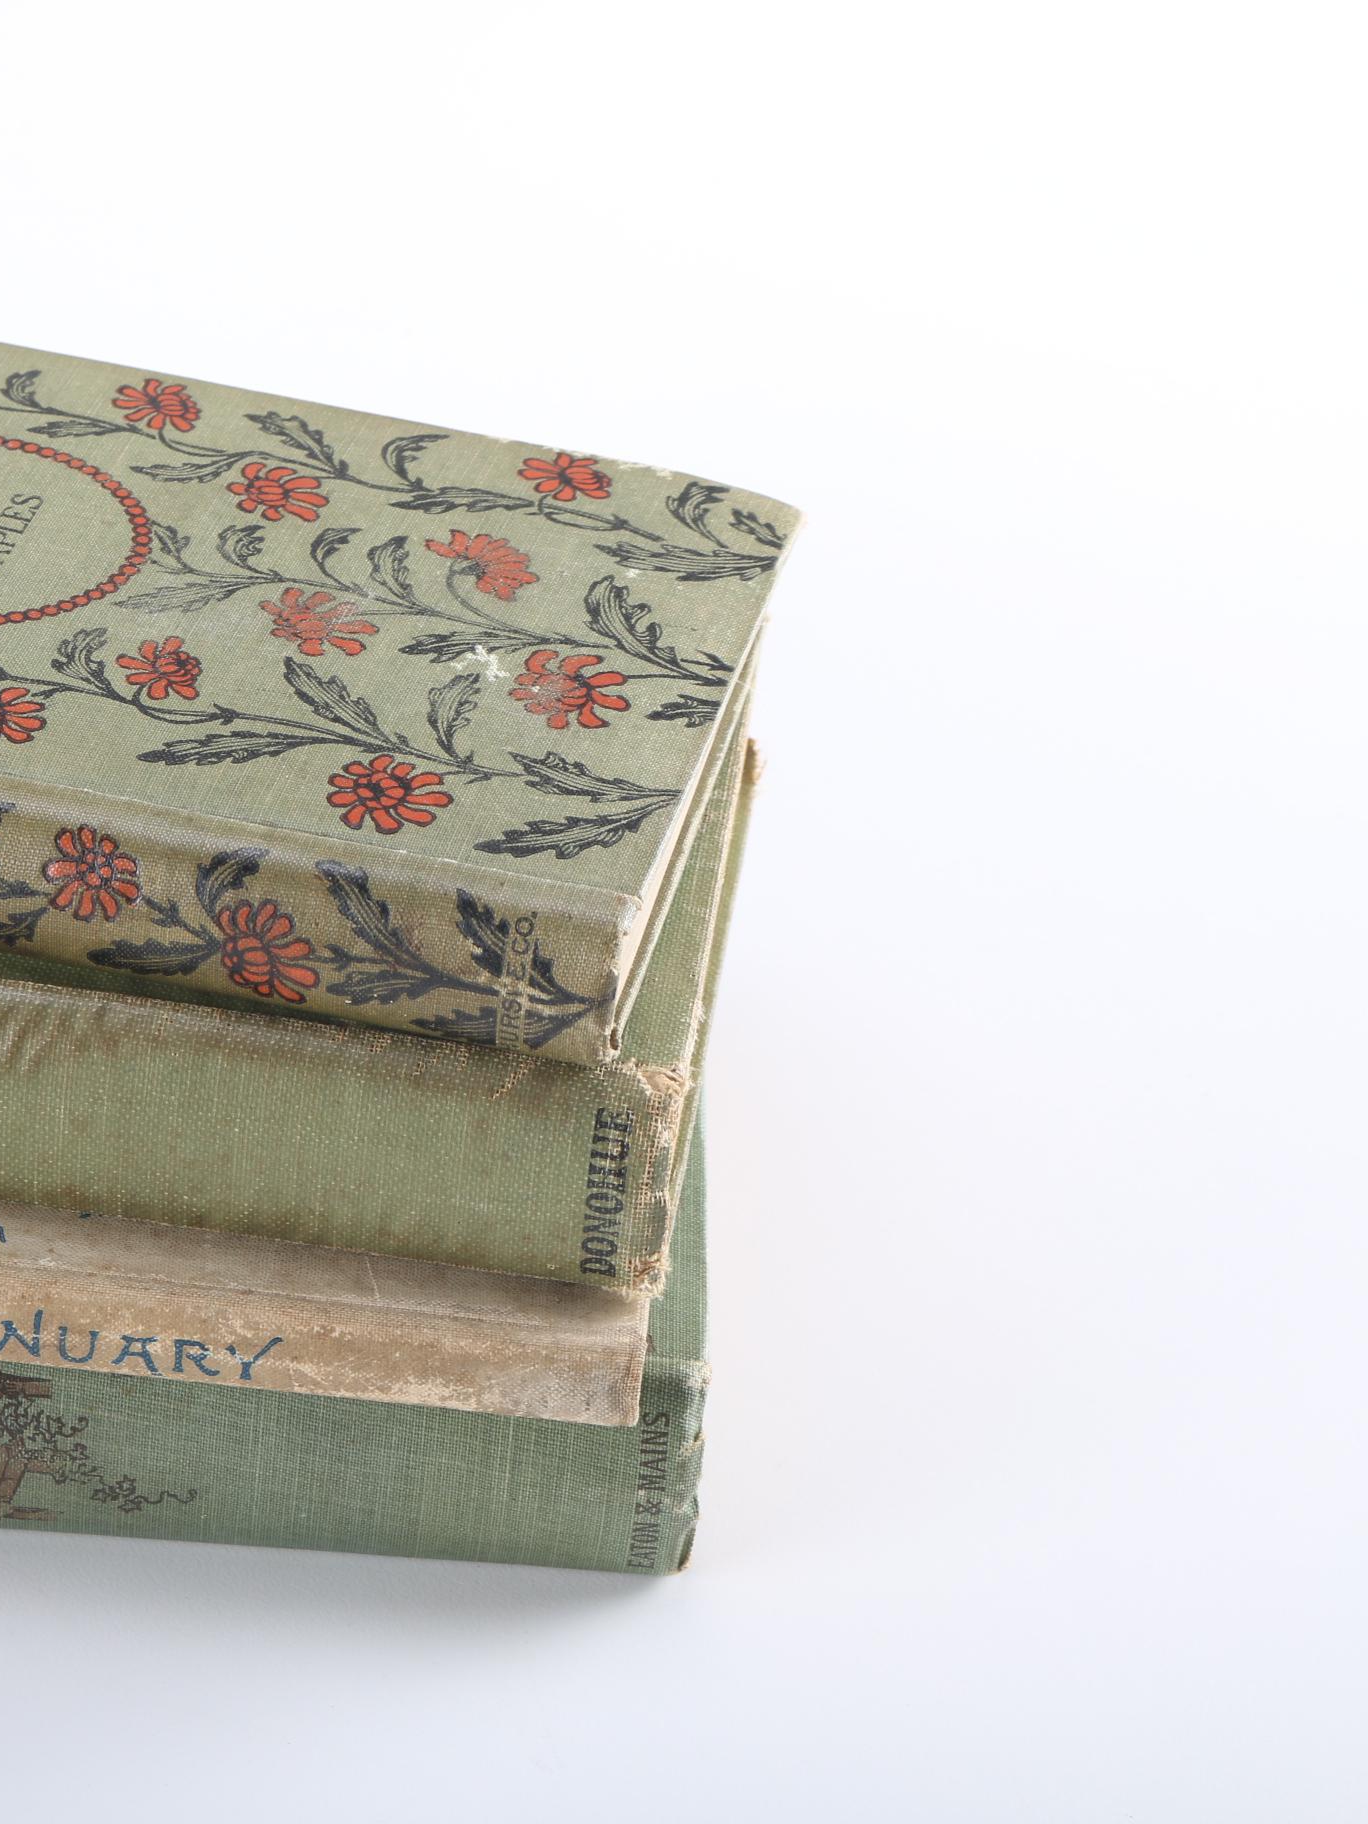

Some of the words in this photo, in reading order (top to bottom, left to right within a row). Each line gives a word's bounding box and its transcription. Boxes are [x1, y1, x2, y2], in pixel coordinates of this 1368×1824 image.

[511, 911, 538, 955] CO.
[579, 1107, 635, 1279] DONOHUE
[638, 1411, 671, 1492] MAINS
[634, 1499, 663, 1516] &
[629, 1522, 660, 1569] EATON
